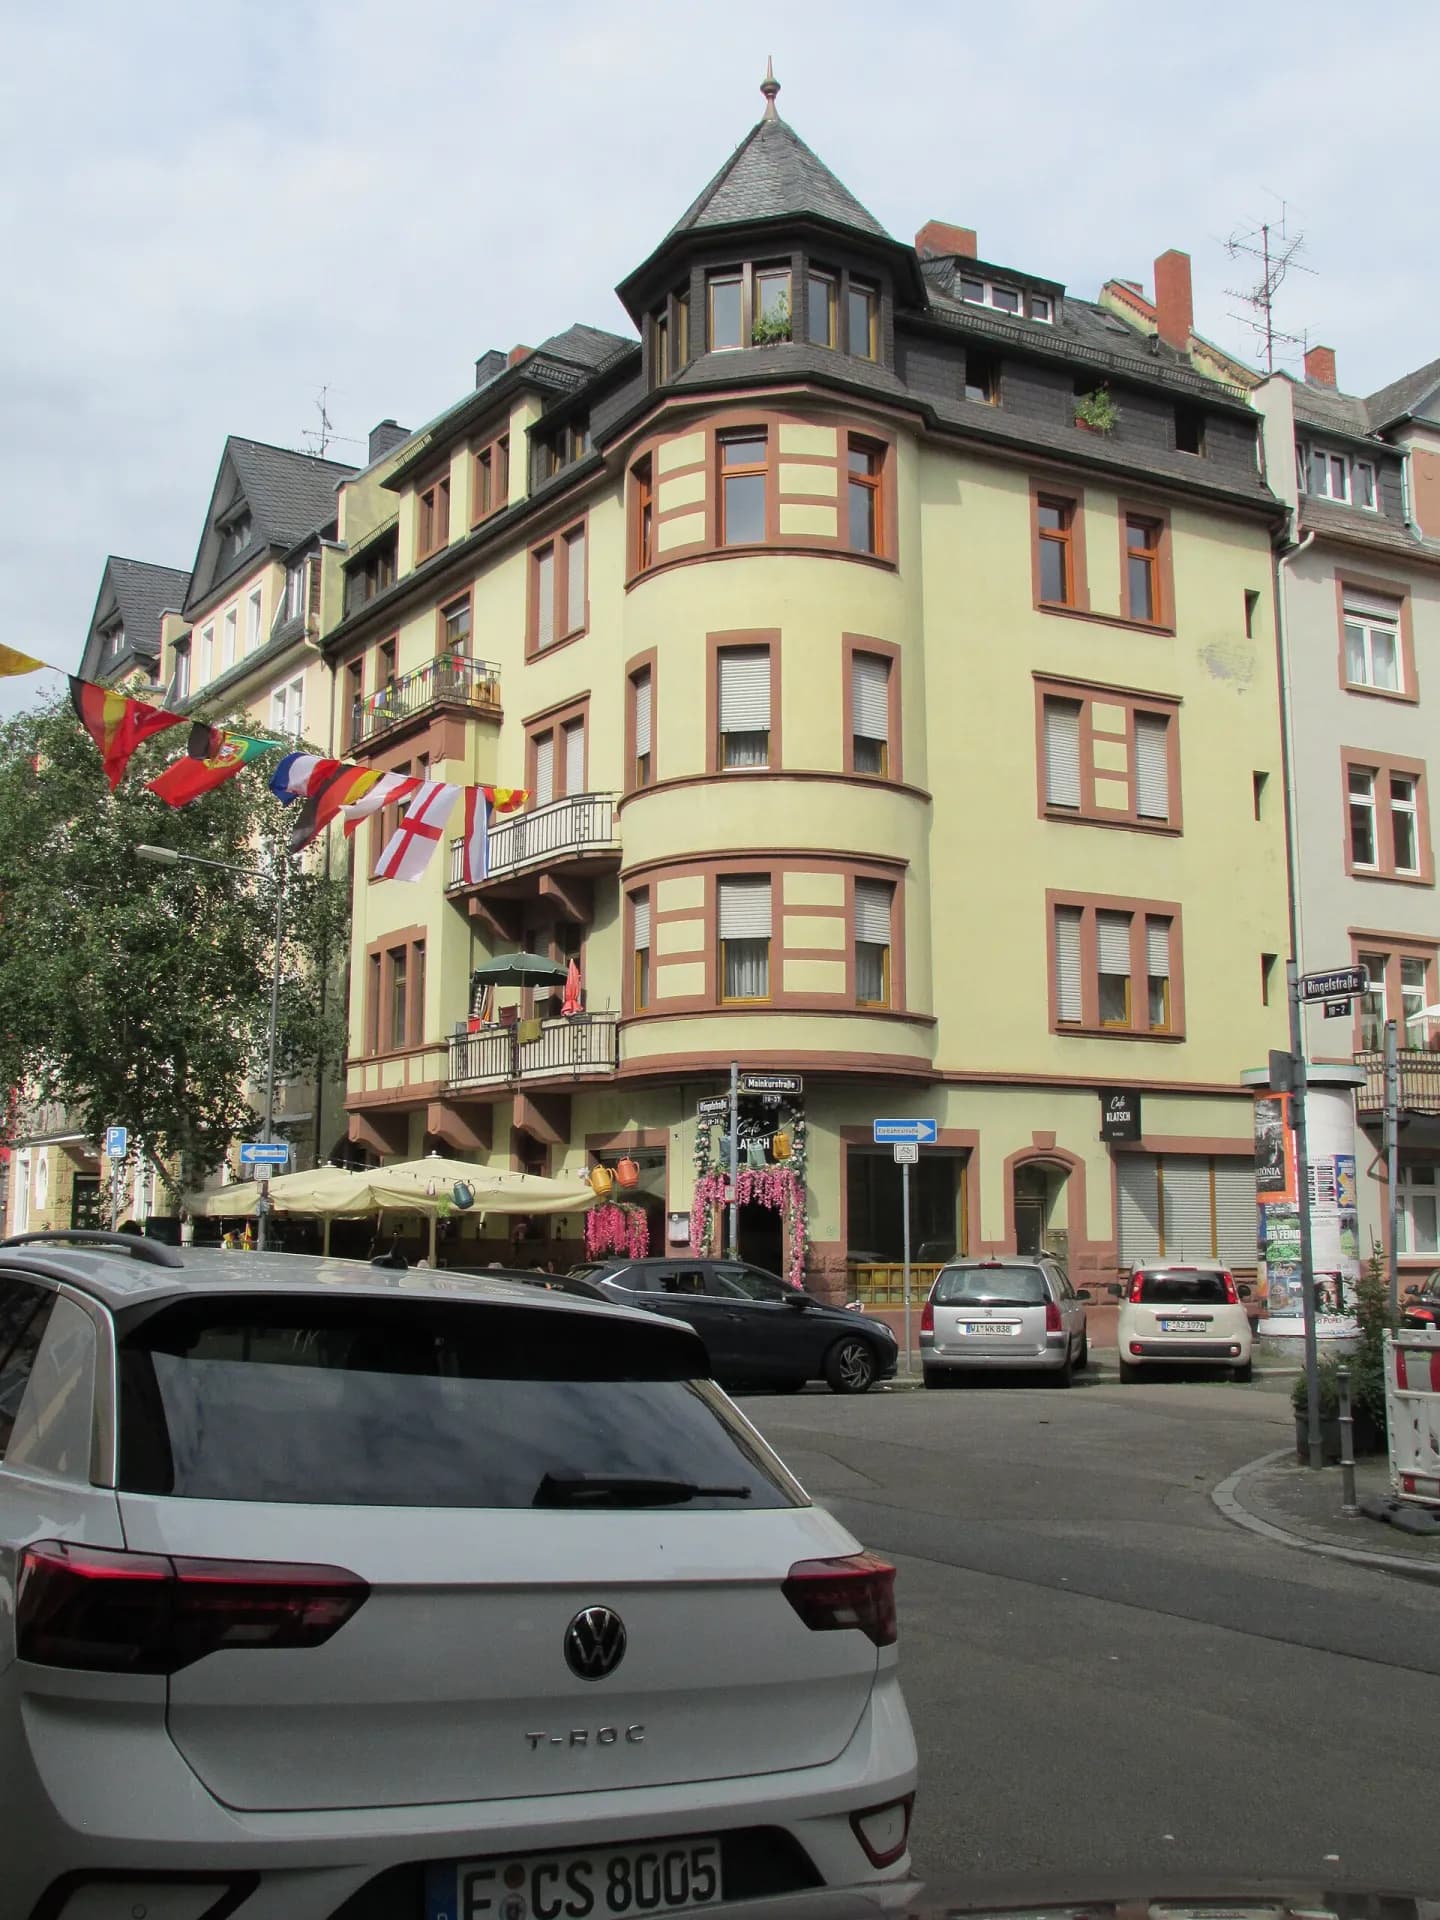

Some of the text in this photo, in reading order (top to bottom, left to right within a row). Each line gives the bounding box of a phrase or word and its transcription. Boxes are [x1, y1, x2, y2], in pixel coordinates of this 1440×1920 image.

[1307, 975, 1358, 994] Ringelstraße
[748, 1079, 796, 1089] Mainkurstraße
[1106, 1111, 1131, 1122] KLATSCH
[526, 1724, 646, 1750] T-ROC
[463, 1847, 716, 1920] F CS 8005
